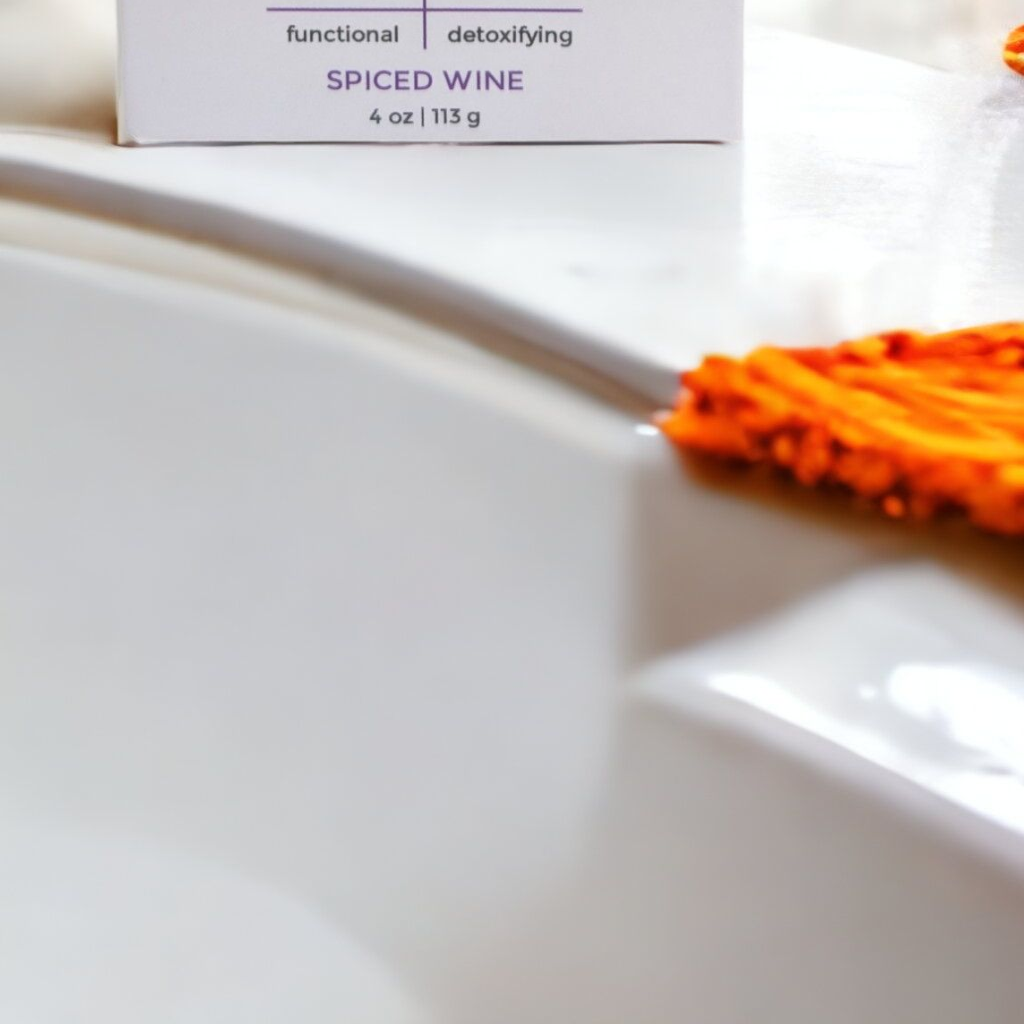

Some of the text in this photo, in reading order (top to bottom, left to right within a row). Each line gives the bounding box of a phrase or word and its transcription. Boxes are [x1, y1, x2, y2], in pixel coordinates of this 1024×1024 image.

[286, 24, 399, 43] functional
[447, 25, 573, 48] detoxifying
[326, 69, 524, 91] SPICED WINE
[369, 107, 381, 125] 4
[388, 111, 414, 125] oz
[431, 107, 462, 125] 113
[466, 111, 481, 129] g
